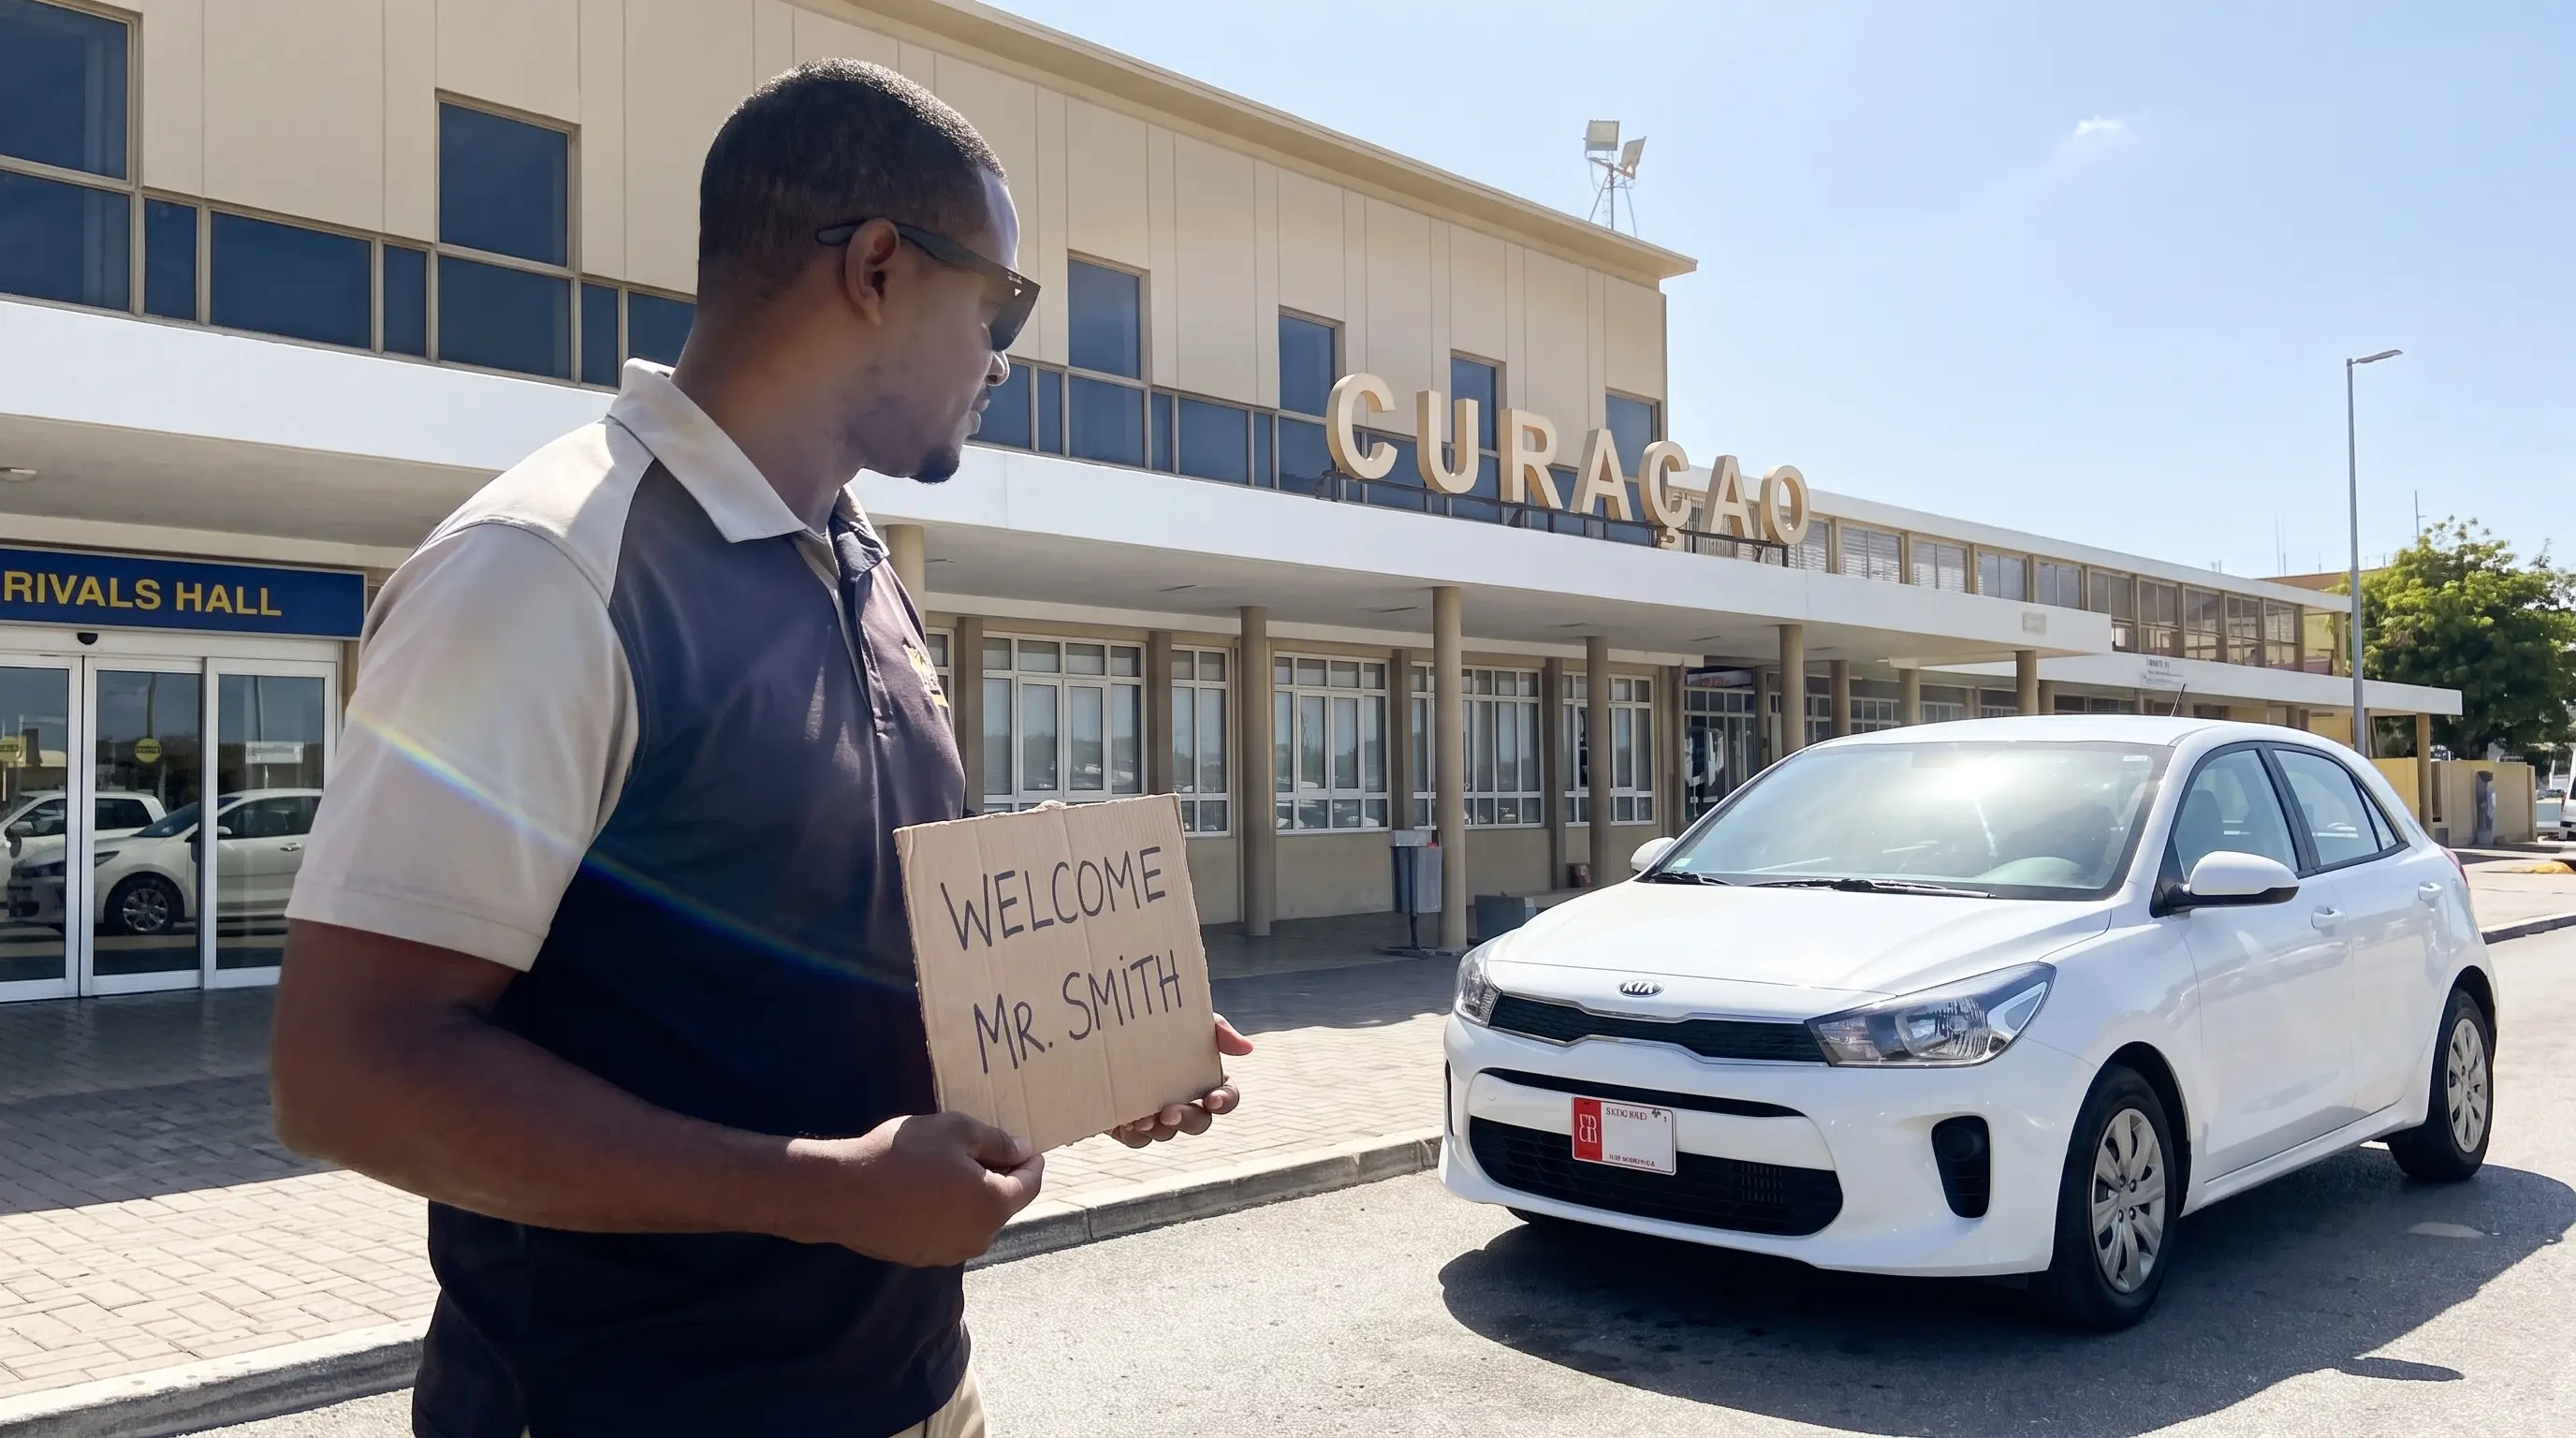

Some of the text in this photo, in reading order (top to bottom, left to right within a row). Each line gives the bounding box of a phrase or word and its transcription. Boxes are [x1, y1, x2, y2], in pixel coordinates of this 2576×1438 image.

[1326, 373, 1809, 550] CURAÇAO
[176, 581, 282, 616] HALL
[940, 845, 1166, 951] WELCOME
[1621, 980, 1655, 994] KIA
